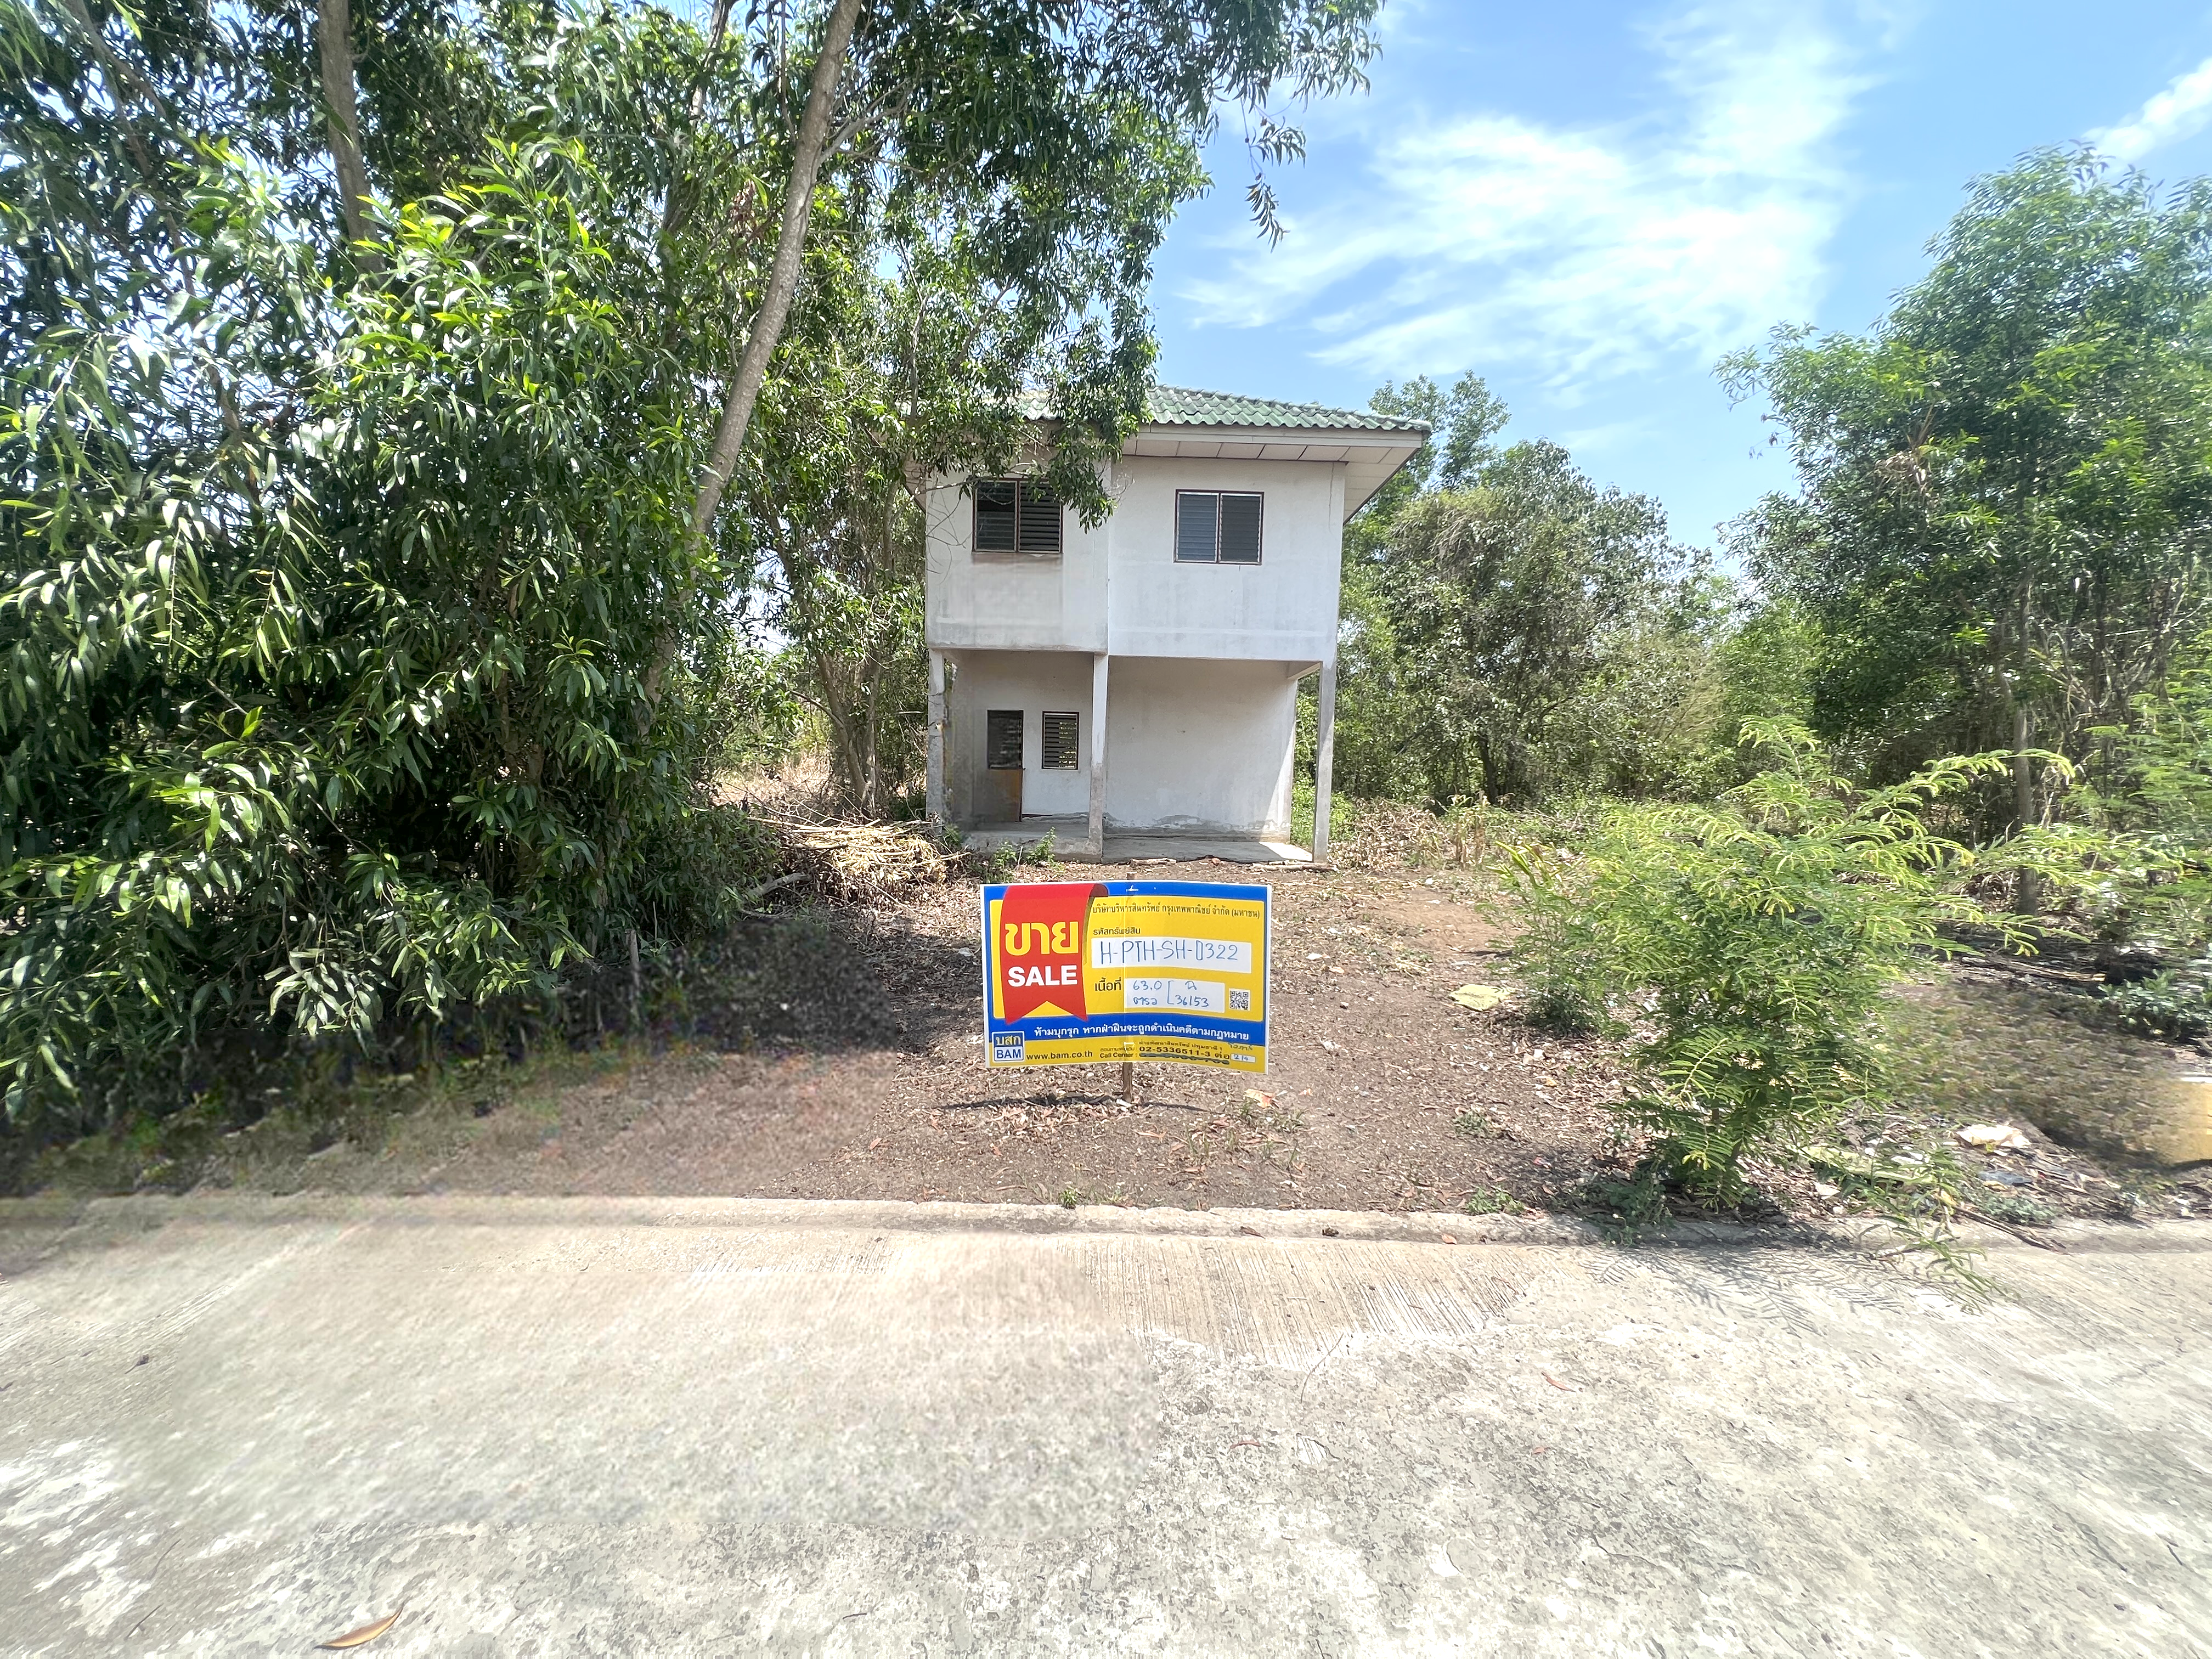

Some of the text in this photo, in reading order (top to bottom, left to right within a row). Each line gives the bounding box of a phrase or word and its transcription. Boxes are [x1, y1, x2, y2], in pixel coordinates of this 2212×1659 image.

[1092, 902, 1260, 919] บริษัทบริหารสินทรัพย์ กรุงเทพพาณิชย์ จำกัด (มหาชน)
[1093, 927, 1141, 935] รหัสทรัพย์สิน
[1005, 921, 1079, 956] ขาย
[1008, 965, 1077, 987] SALE
[1094, 977, 1122, 992] เนื้อที่
[1034, 1026, 1079, 1039] ห้ามบุกรุก
[995, 1035, 1021, 1046] บสก
[996, 1048, 1021, 1059] BAM
[1026, 1051, 1093, 1060] www.bam.co.th
[1215, 1051, 1230, 1059] ต่อ
